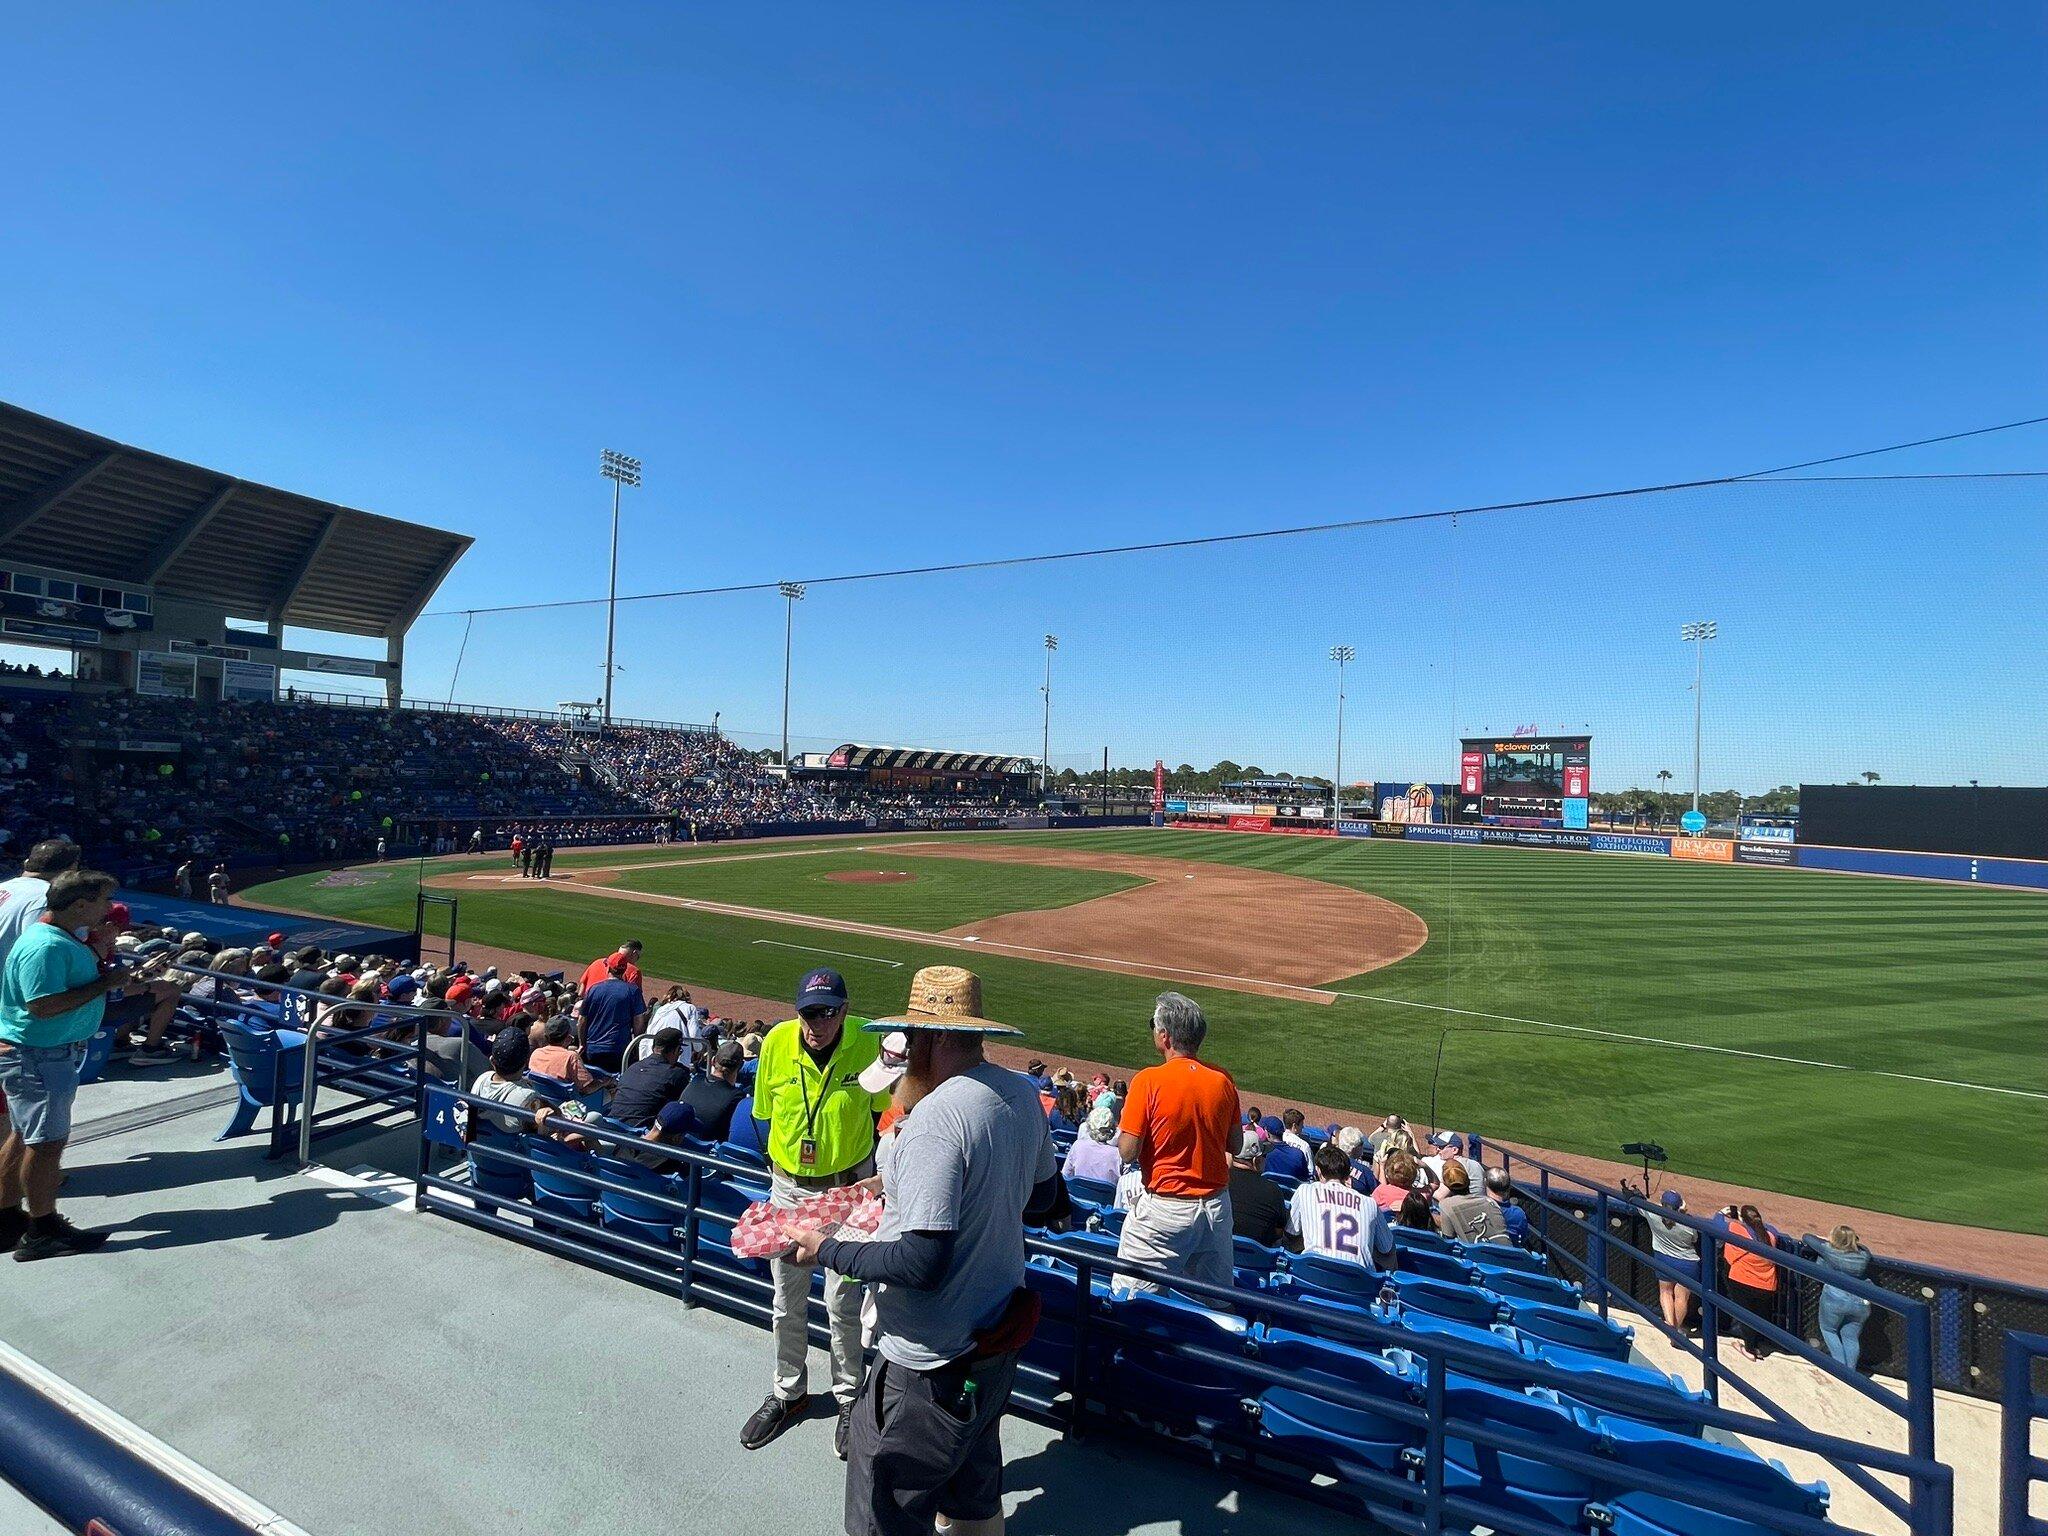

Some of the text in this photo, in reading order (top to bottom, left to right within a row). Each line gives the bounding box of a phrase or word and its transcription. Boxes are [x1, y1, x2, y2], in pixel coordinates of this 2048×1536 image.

[904, 819, 928, 827] PREMIO
[1339, 822, 1368, 830] LEGLER
[1744, 827, 1790, 838] ELITE
[1596, 836, 1664, 846] SOUTH FLORIDA
[1596, 842, 1665, 853] ORTHOPAEDICS
[435, 1110, 445, 1124] 4
[1315, 1187, 1361, 1212] LINDOR
[1320, 1209, 1359, 1256] 12
